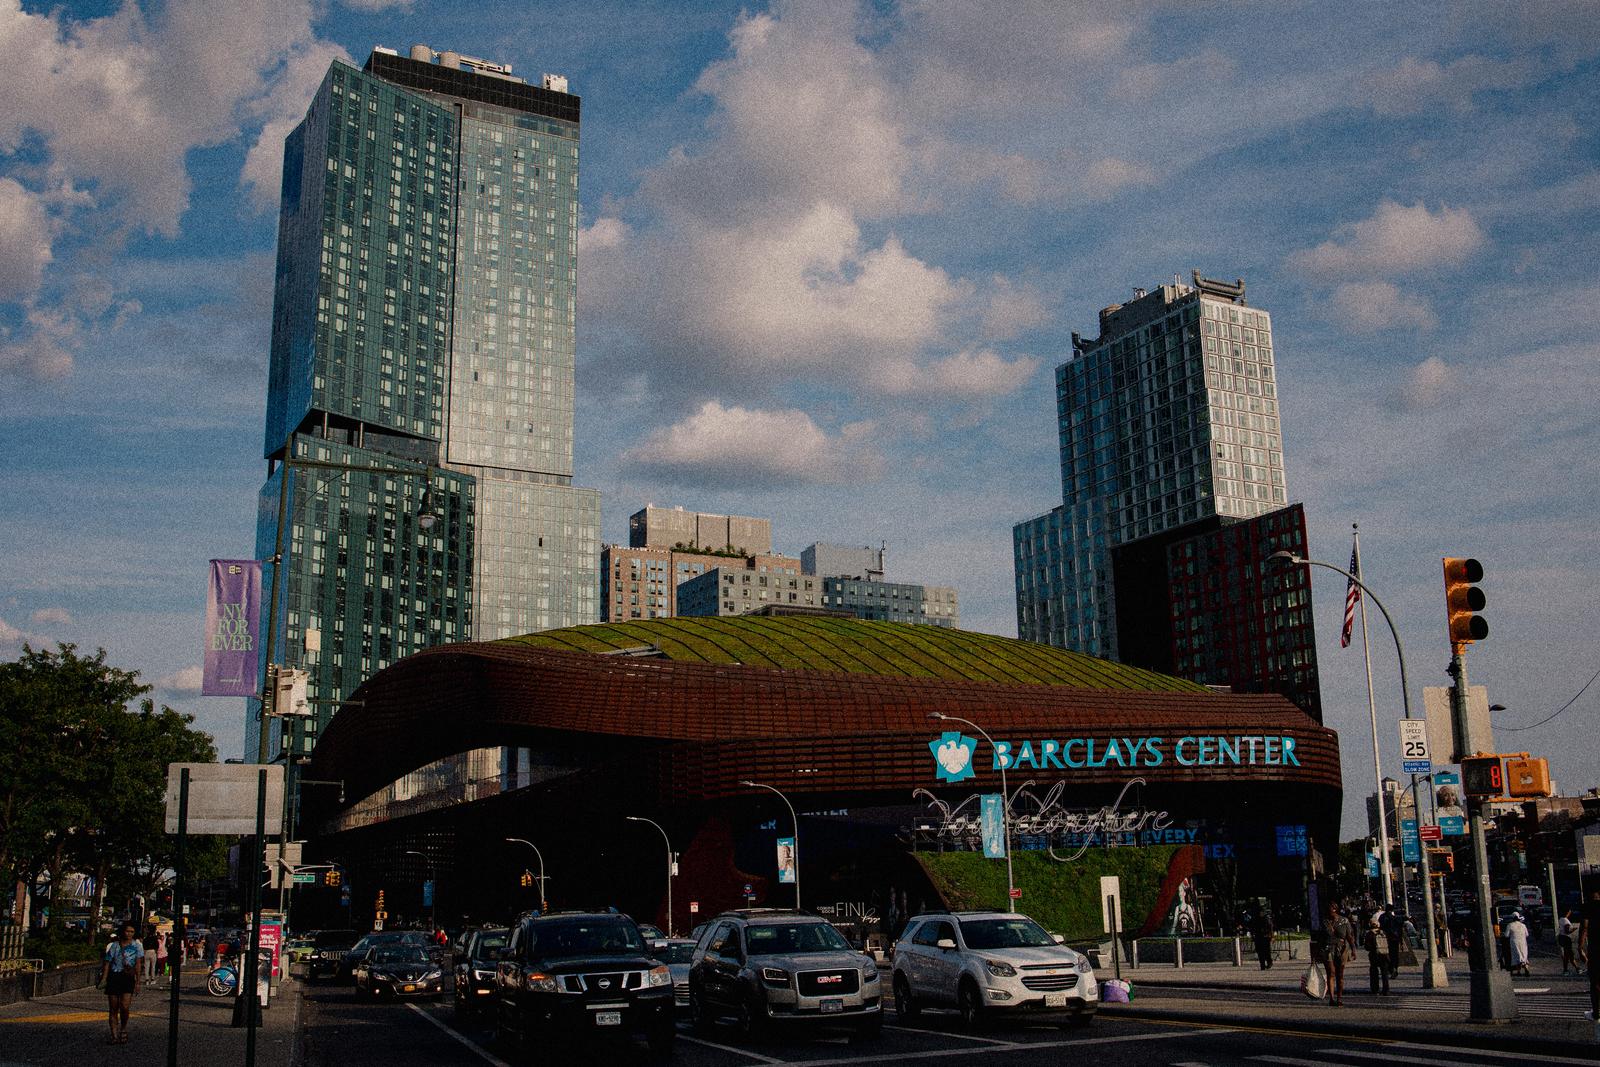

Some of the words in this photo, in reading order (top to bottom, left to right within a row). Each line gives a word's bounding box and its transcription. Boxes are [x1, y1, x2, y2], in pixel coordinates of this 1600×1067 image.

[223, 603, 242, 619] NY
[217, 618, 249, 635] FOR
[211, 634, 253, 651] EVER
[992, 737, 1164, 771] BARCLAYS
[1174, 736, 1300, 768] CENTER
[1405, 742, 1426, 757] 25
[836, 901, 865, 917] FINI
